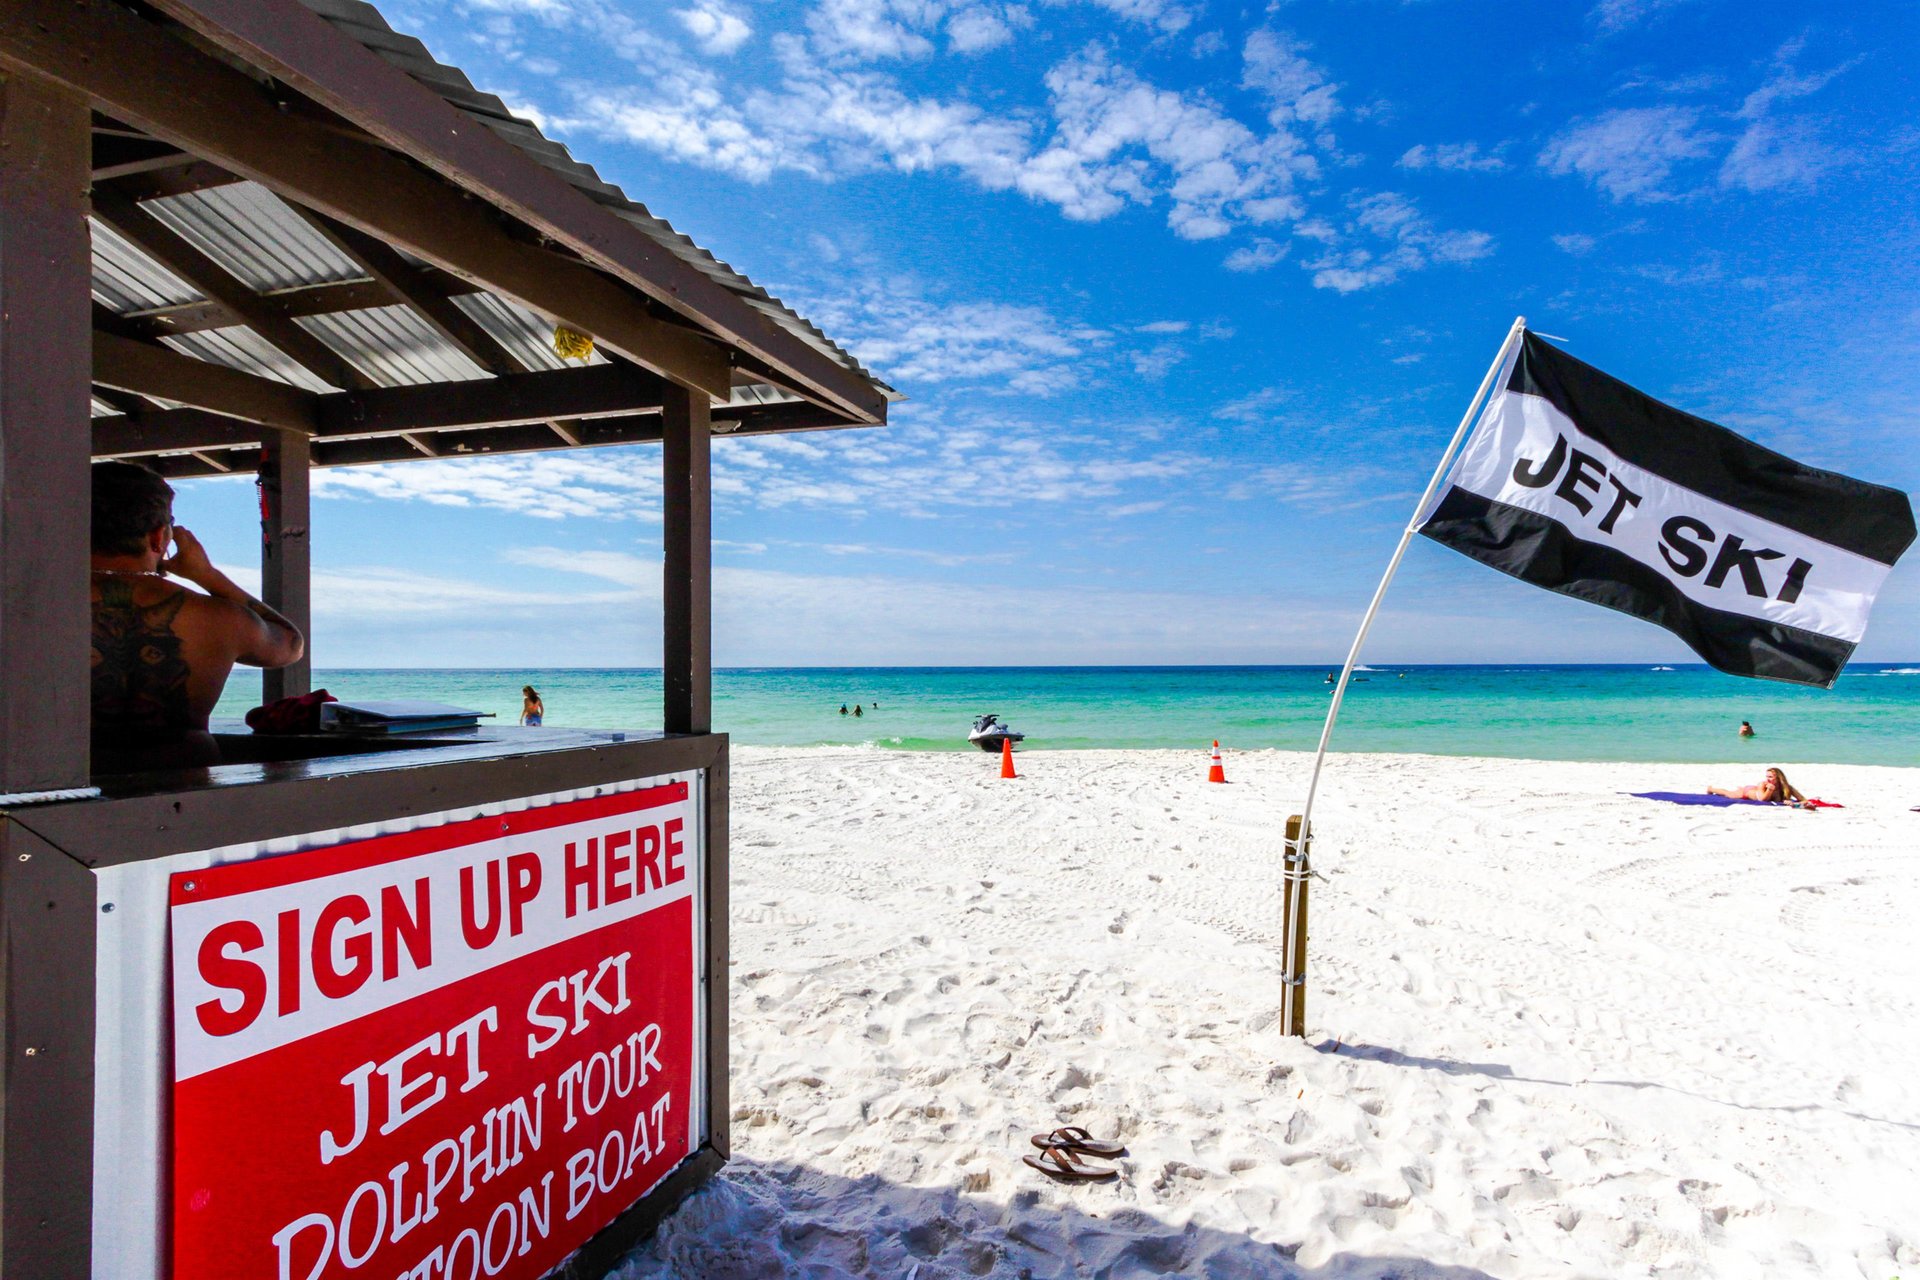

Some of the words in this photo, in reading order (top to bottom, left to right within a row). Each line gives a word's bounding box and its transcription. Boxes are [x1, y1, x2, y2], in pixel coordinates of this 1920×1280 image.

[1513, 433, 1642, 534] JET
[1658, 516, 1812, 602] SKI
[196, 878, 431, 1037] SIGN
[461, 852, 541, 949] UP
[566, 818, 685, 918] HERE
[272, 1083, 545, 1280] DOLPHIN
[557, 1023, 662, 1131] TOUR
[321, 1006, 497, 1164] JET
[528, 952, 631, 1058] SKI
[396, 1171, 553, 1280] TOON
[566, 1093, 670, 1220] BOAT
